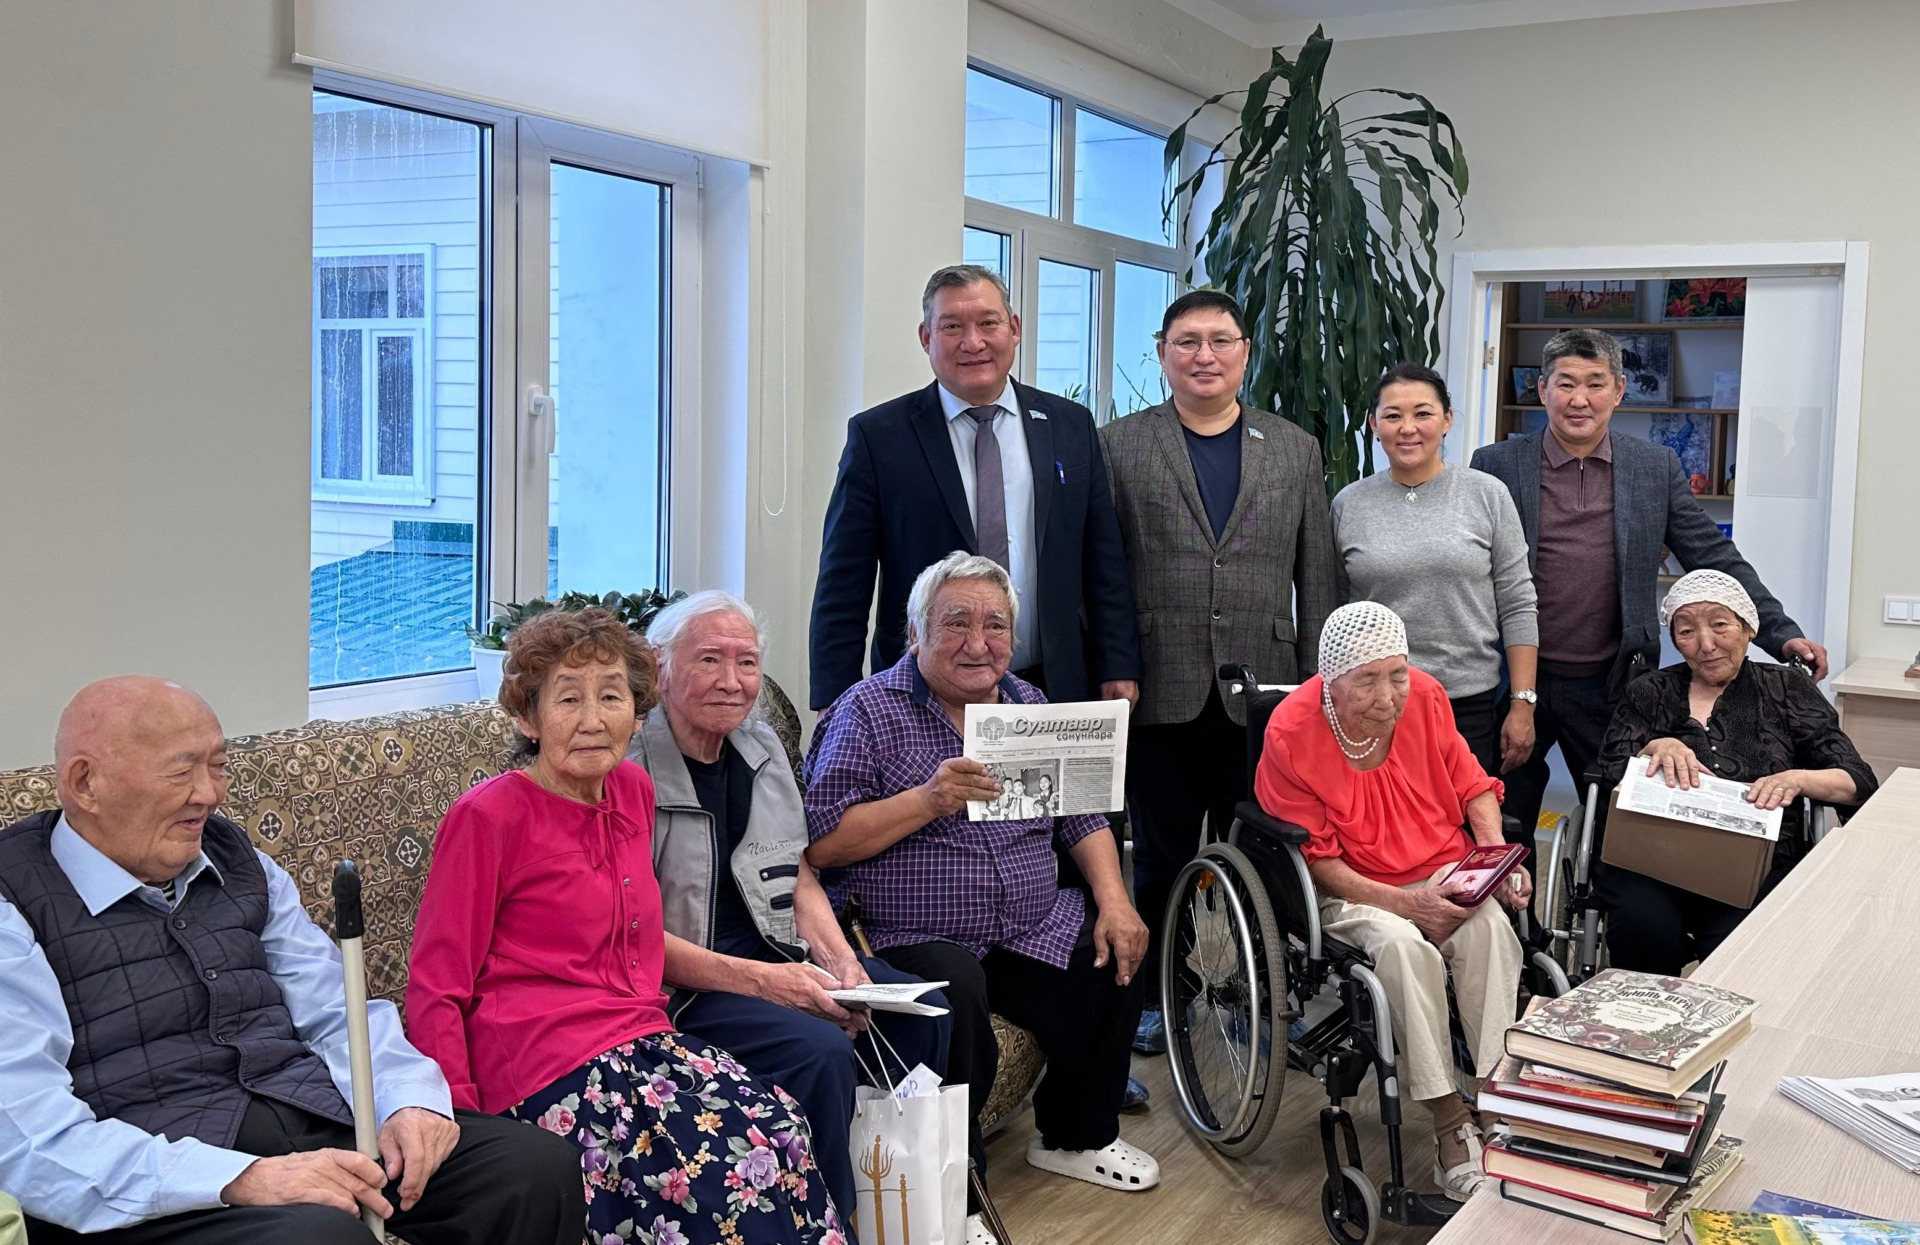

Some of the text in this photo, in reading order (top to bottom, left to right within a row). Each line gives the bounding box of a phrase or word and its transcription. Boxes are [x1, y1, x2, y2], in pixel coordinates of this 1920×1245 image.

[1012, 717, 1104, 737] Сунтаар
[1618, 990, 1661, 999] ЖЮЛЬ
[1664, 995, 1693, 1011] ВЕРН
